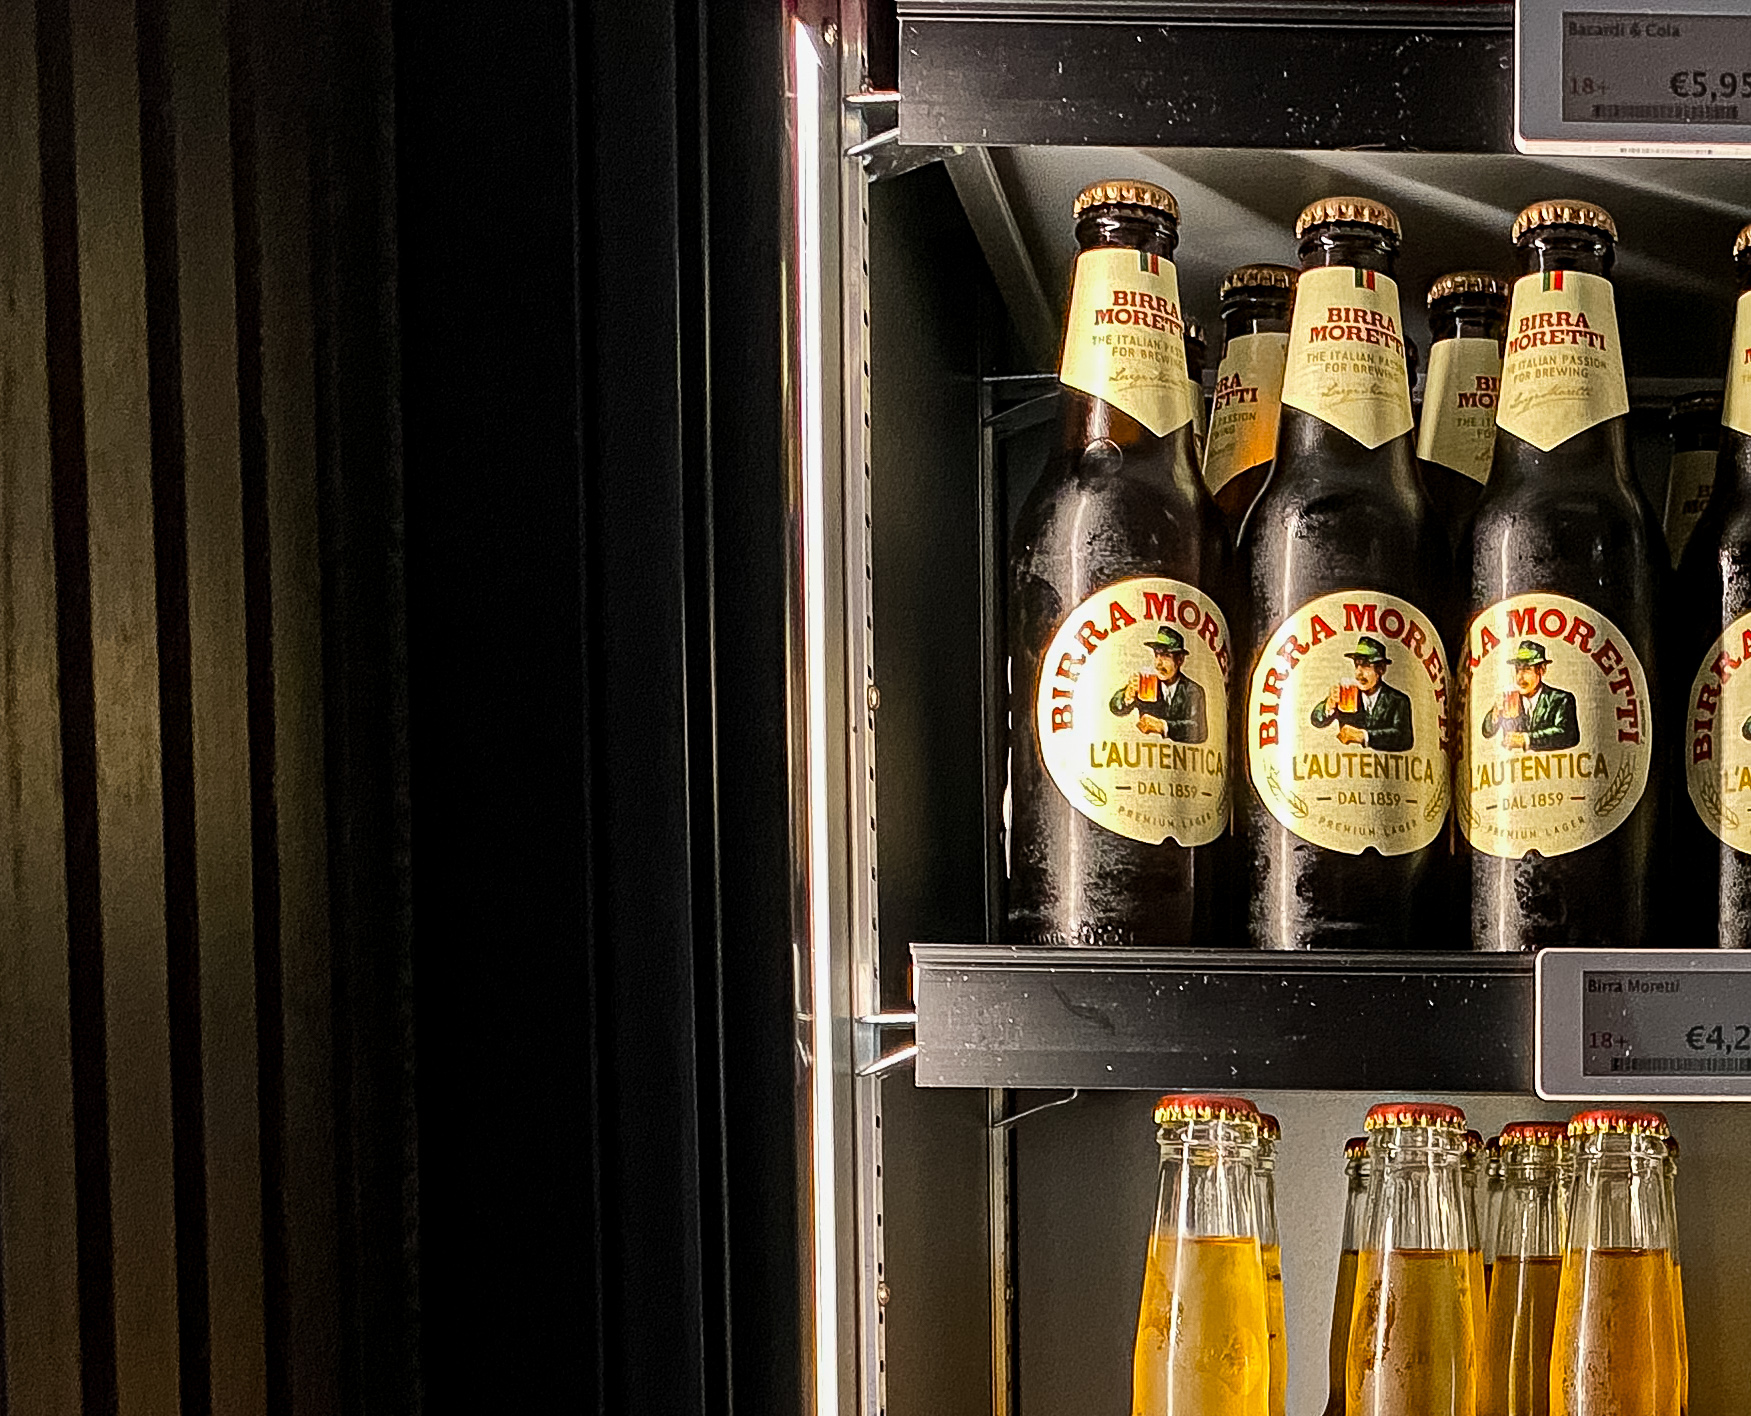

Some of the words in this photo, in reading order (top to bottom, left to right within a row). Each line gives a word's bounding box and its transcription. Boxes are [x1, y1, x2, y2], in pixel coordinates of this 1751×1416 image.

[1568, 22, 1625, 37] Bacardi
[1629, 23, 1641, 38] &
[1645, 23, 1680, 38] Cola
[1570, 77, 1608, 95] 18+
[1112, 290, 1180, 319] BIRRA
[1094, 308, 1184, 341] MORETT
[1327, 307, 1396, 334] BIRRA
[1519, 312, 1590, 334] BIRRA
[1117, 334, 1162, 350] ITALIAN
[1508, 330, 1606, 357] MORETTI
[1330, 352, 1374, 364] ITALIAN
[1518, 356, 1557, 370] ITALIAN
[1535, 365, 1589, 379] BREWING
[1051, 600, 1136, 733] BIRRA
[1143, 592, 1228, 676] MORE
[1260, 614, 1336, 748] BIRRA
[1507, 608, 1644, 744] MORETTI
[1090, 743, 1224, 777] L'AUTENTICA
[1292, 753, 1434, 781] L'AUTENTICA
[1469, 753, 1608, 792] L'AUTENTICA
[1138, 781, 1166, 797] DAL
[1169, 782, 1197, 798] 1859
[1338, 791, 1366, 806] DAL
[1370, 792, 1400, 807] 1859
[1502, 795, 1527, 811] DAL
[1530, 792, 1563, 808] 1859
[1588, 980, 1623, 993] Birra
[1628, 980, 1679, 993] Moretti
[1589, 1032, 1628, 1049] 18+
